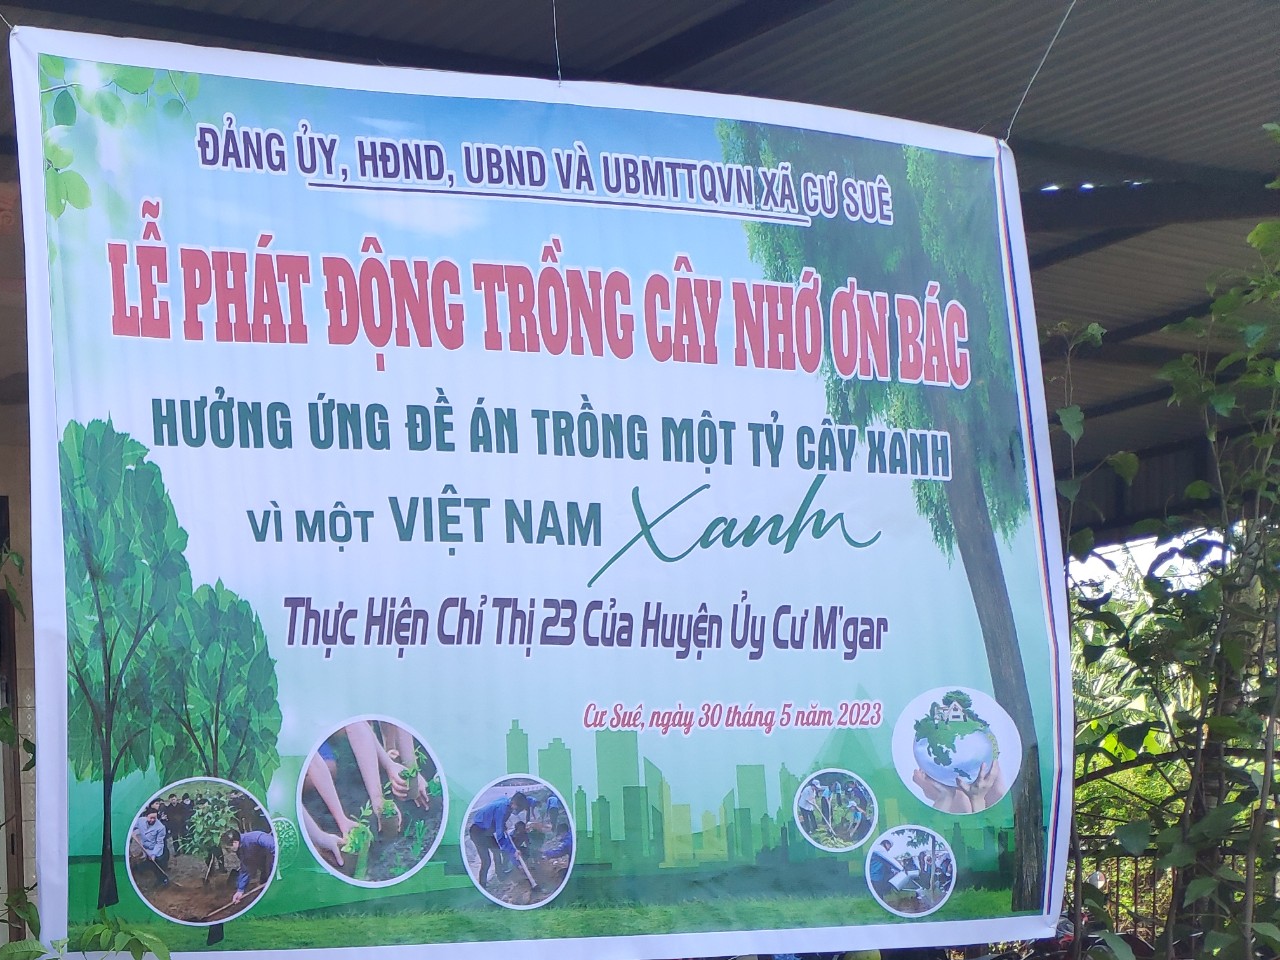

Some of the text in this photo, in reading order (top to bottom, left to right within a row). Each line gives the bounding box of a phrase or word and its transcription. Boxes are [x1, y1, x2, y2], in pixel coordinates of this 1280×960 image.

[198, 117, 892, 222] ĐẢNG ỦY, HĐND, UBND VÀ UBMTTQVN XÃ CƯ SUÊ
[108, 200, 971, 386] LỄ PHÁT ĐỘNG TRỒNG CÂY NHỚ ƠN BÁC
[152, 386, 950, 477] HƯỞNG ỨNG ĐỀ ÁN TRỒNG MỘT TỶ CÂY XANH
[247, 474, 881, 588] VÌ MỘT VIỆT NAM Xanh
[284, 590, 888, 660] Thực Hiện Chỉ Thị 23 Của Huyện Ủy Cư M'gar
[584, 702, 881, 735] Cư Suê, ngày 30 tháng 5 năm 2023
